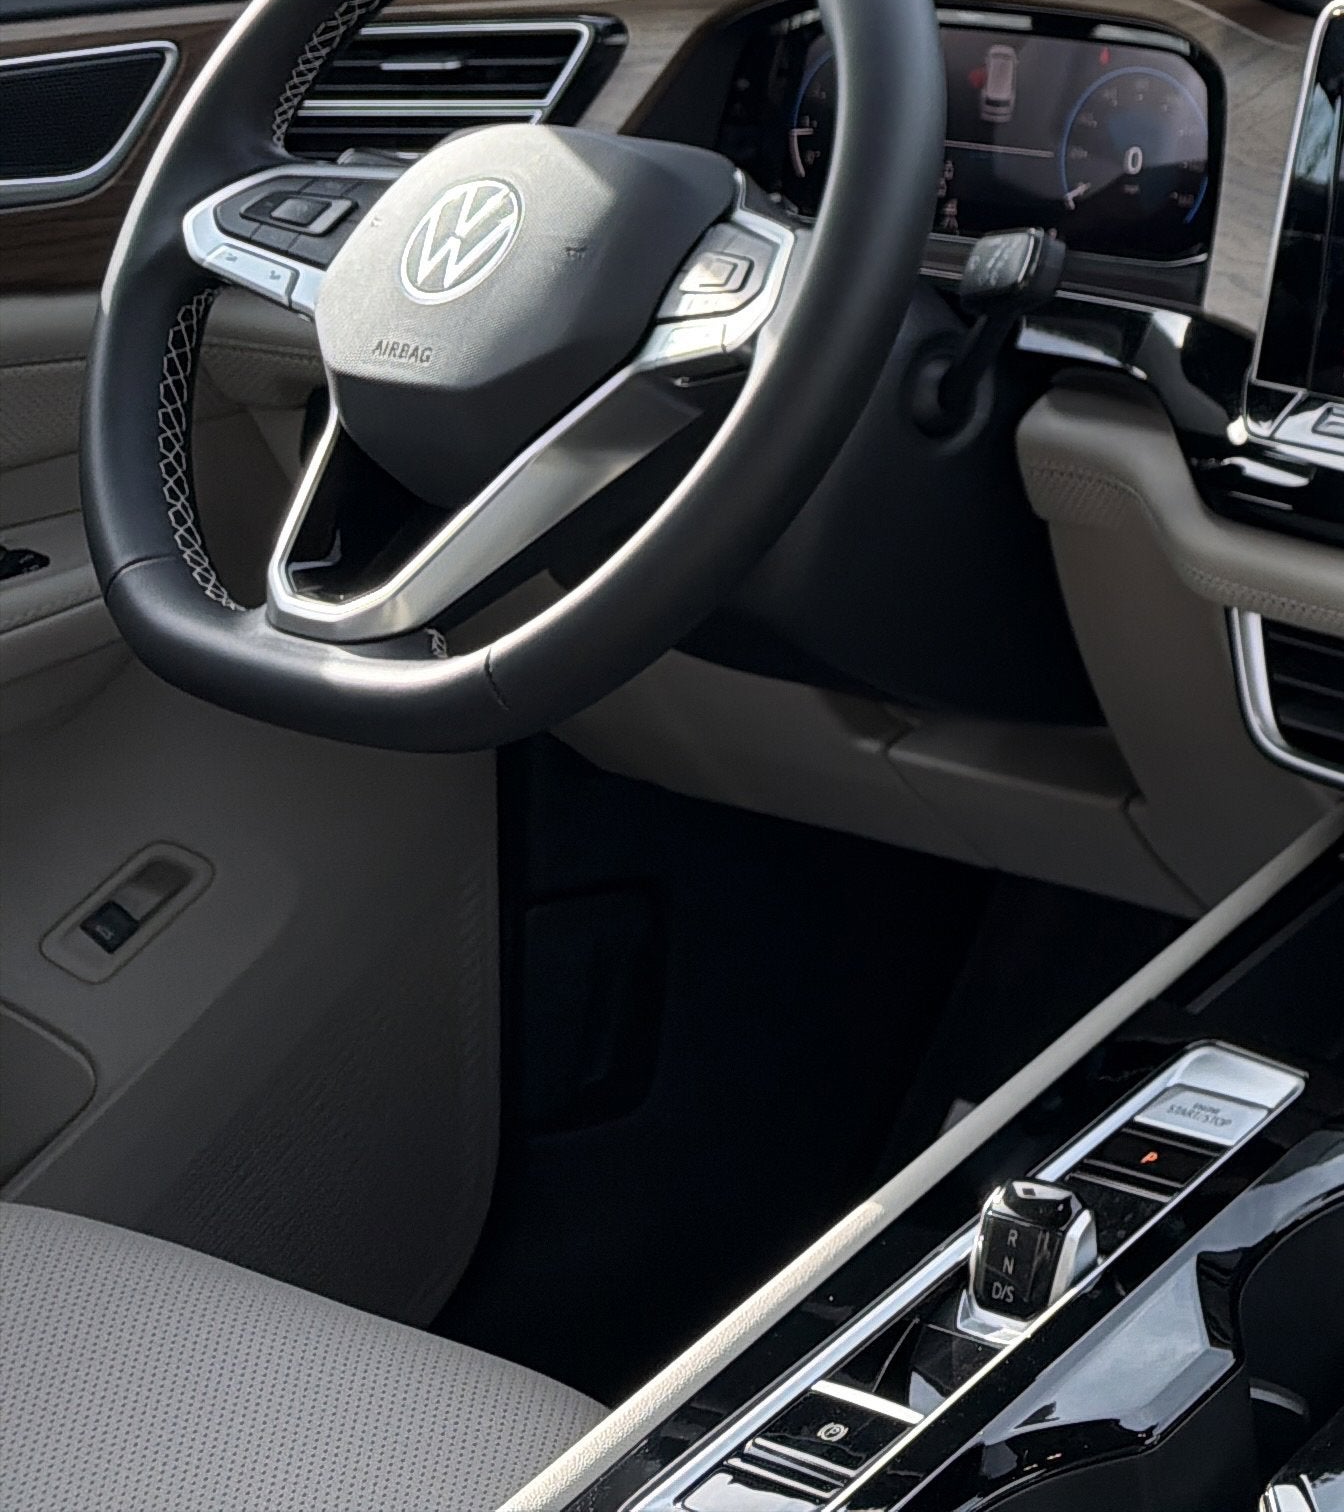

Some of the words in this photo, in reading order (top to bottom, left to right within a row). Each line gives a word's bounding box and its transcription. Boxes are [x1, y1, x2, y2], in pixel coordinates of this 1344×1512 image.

[1126, 146, 1143, 175] 0
[372, 339, 433, 364] AIRBAG
[1140, 1151, 1158, 1164] P
[1006, 1229, 1018, 1248] R
[1002, 1256, 1015, 1275] N
[991, 1281, 1015, 1303] D/S
